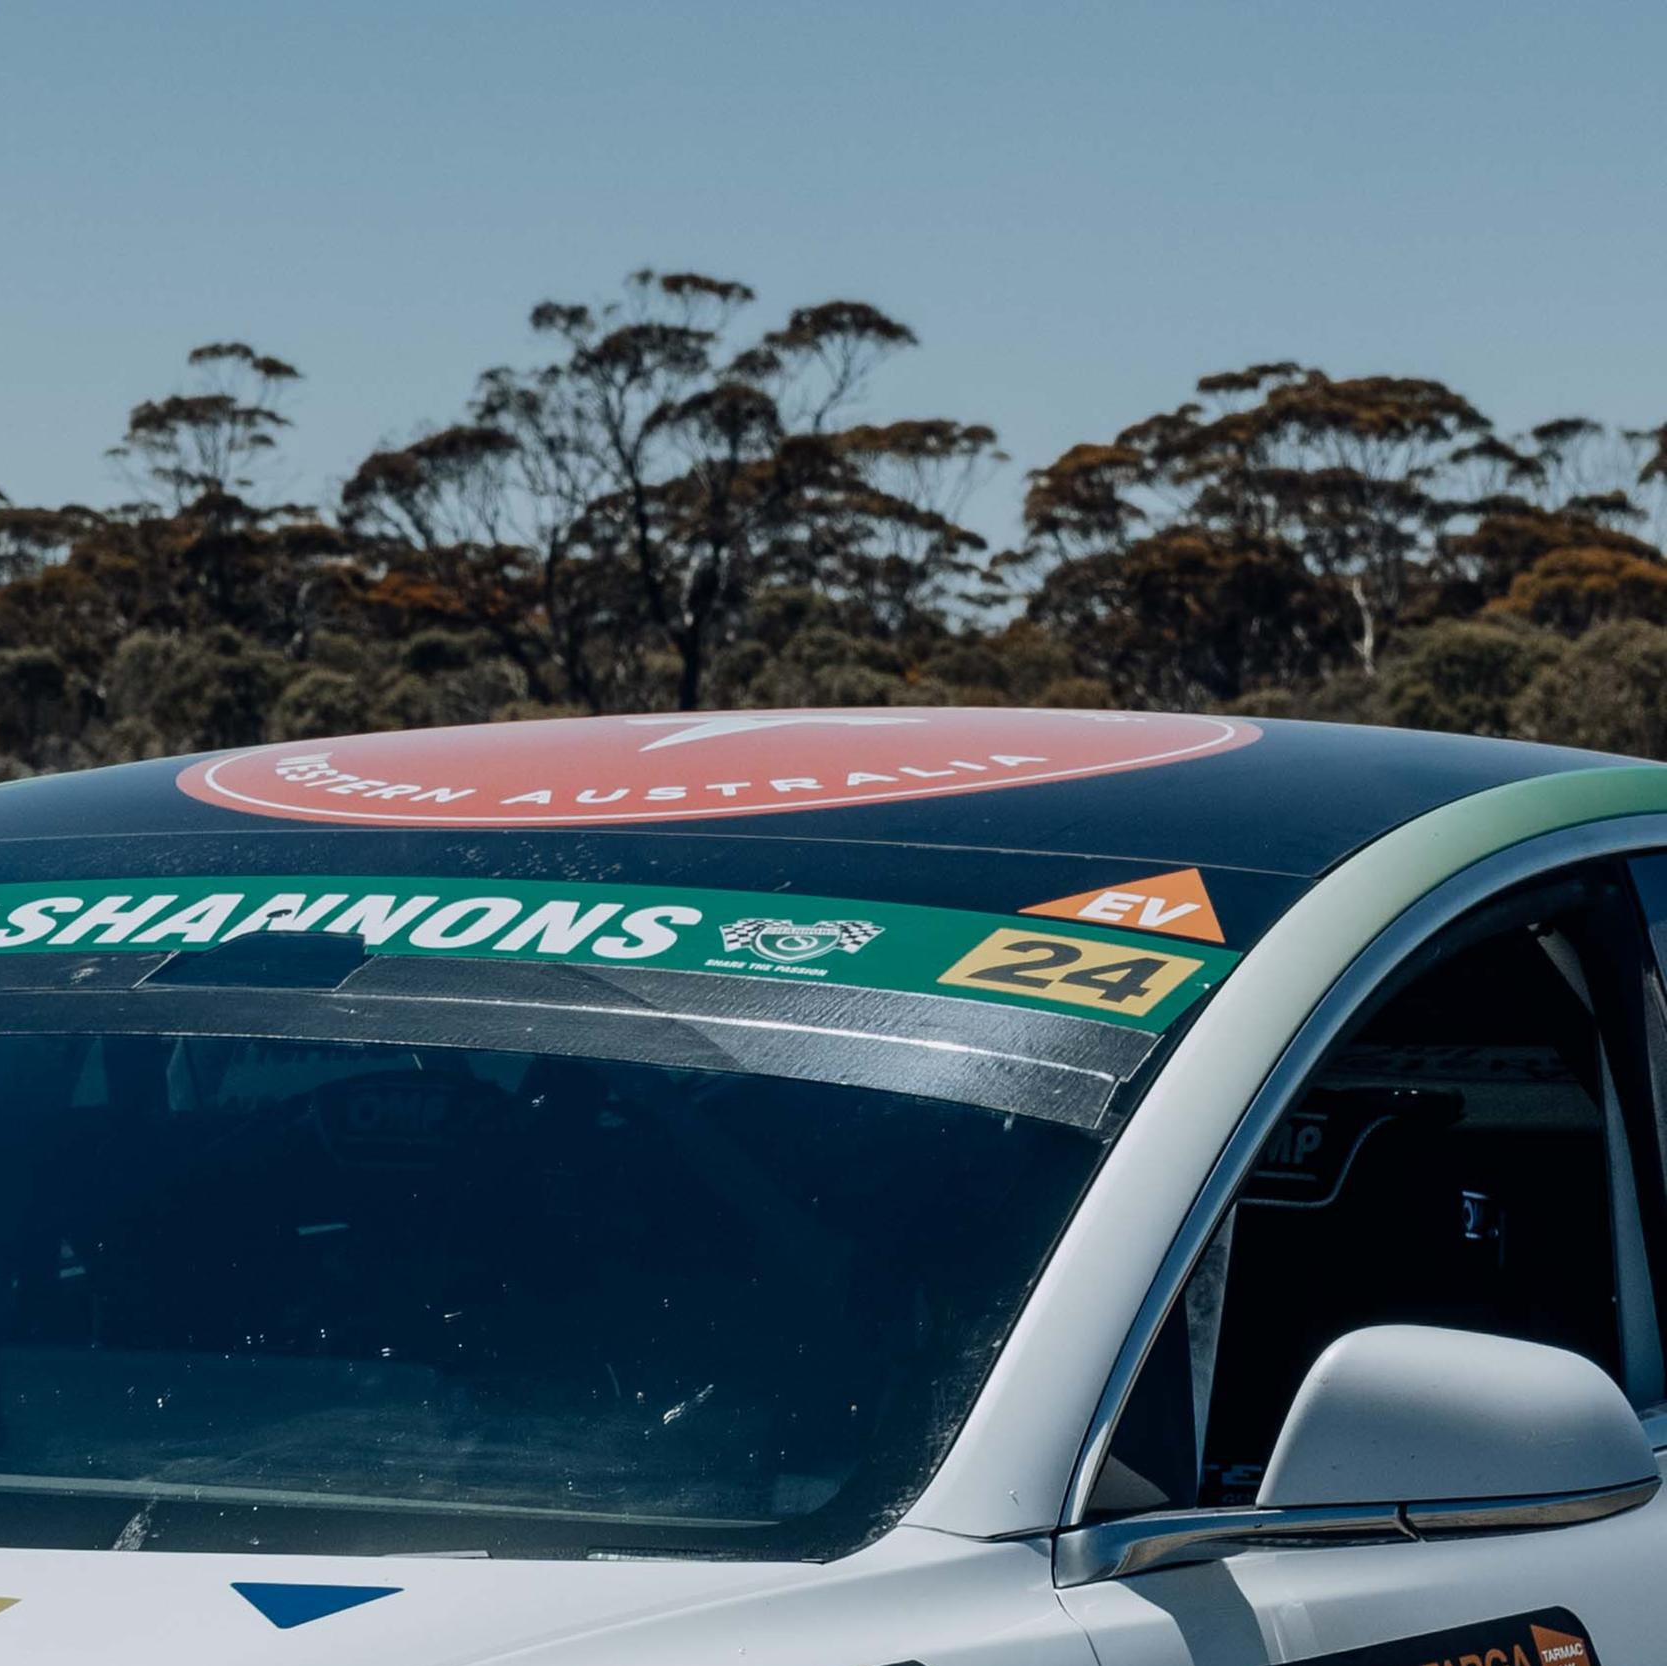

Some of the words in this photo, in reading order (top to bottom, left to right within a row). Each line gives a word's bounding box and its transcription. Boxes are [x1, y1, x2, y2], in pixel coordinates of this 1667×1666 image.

[274, 752, 476, 804] WESTERN
[500, 754, 1048, 804] AUSTRALIA
[1077, 891, 1202, 928] EV
[966, 940, 1169, 1003] 24
[1541, 1642, 1585, 1664] TARMAC
